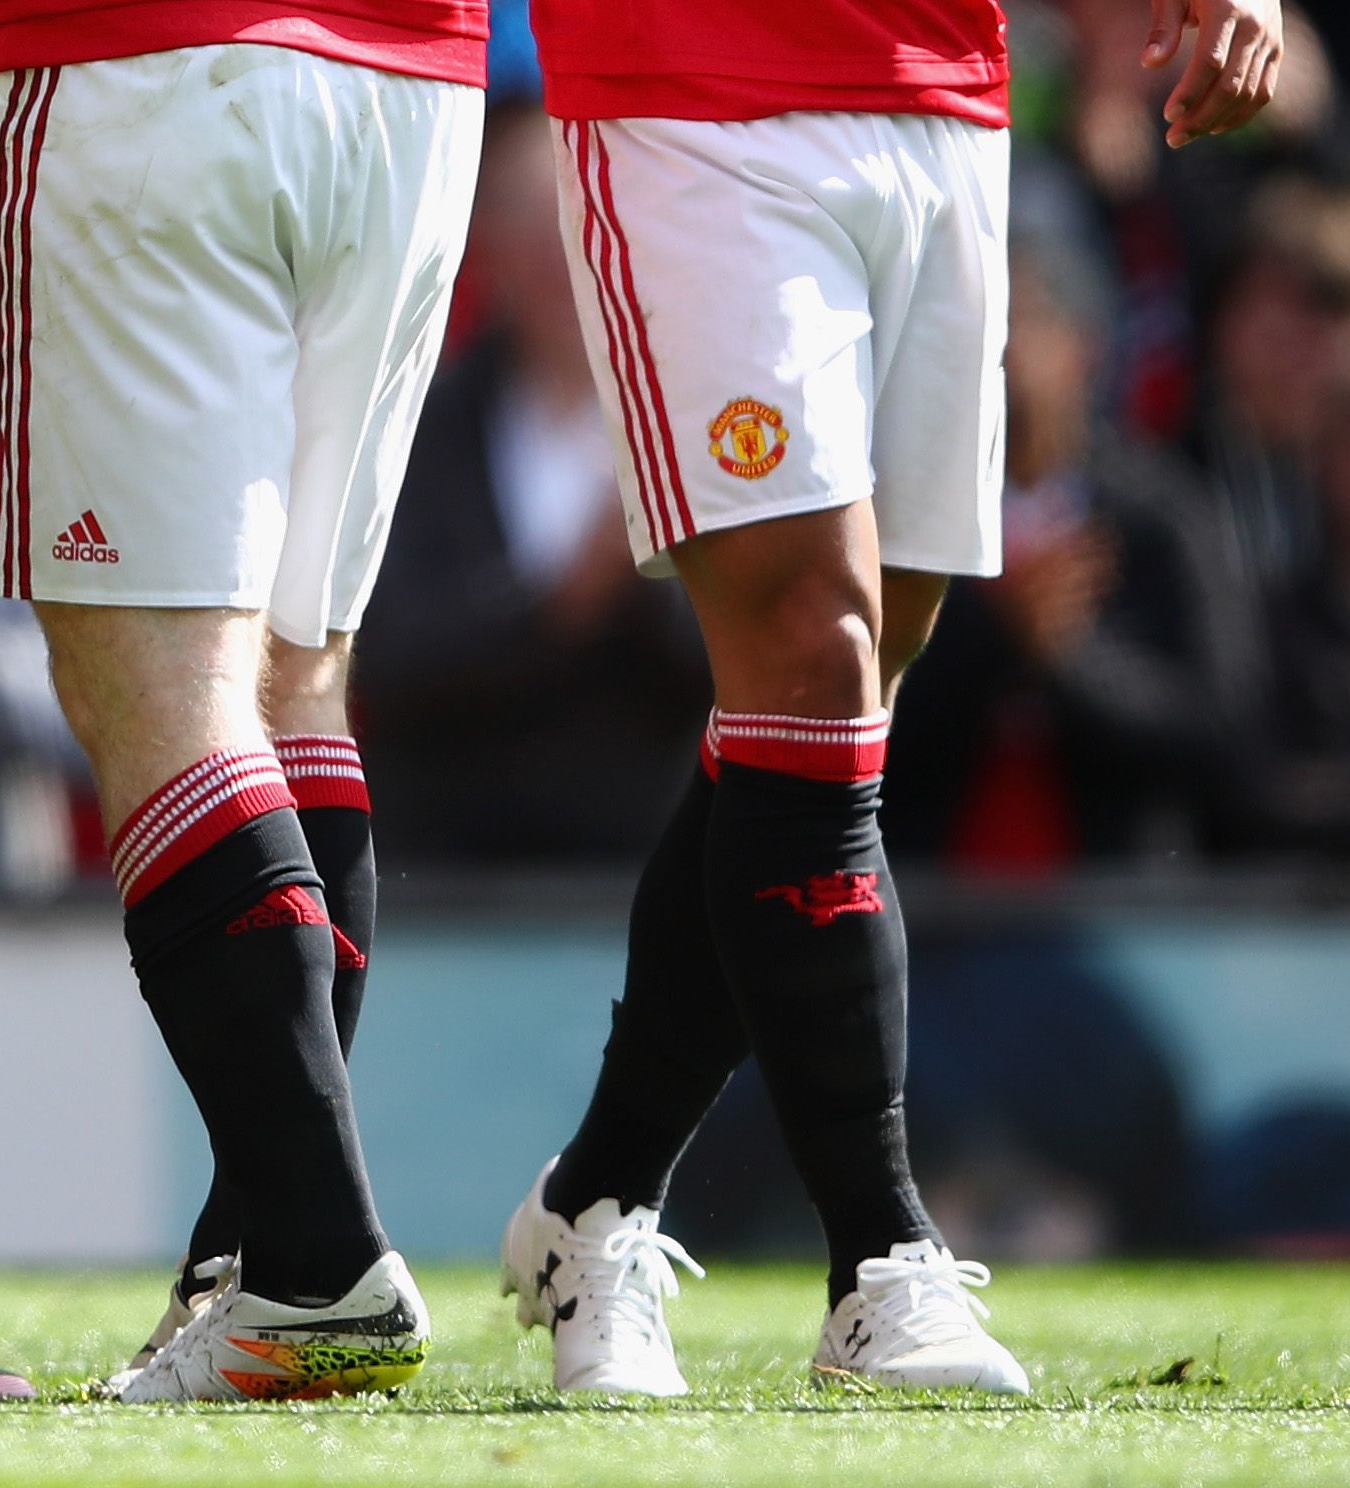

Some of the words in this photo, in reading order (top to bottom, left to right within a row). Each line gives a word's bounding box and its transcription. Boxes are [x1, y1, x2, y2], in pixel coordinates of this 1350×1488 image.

[714, 401, 776, 436] MANCHESTER
[732, 455, 776, 475] UNITED
[52, 541, 120, 564] adidas
